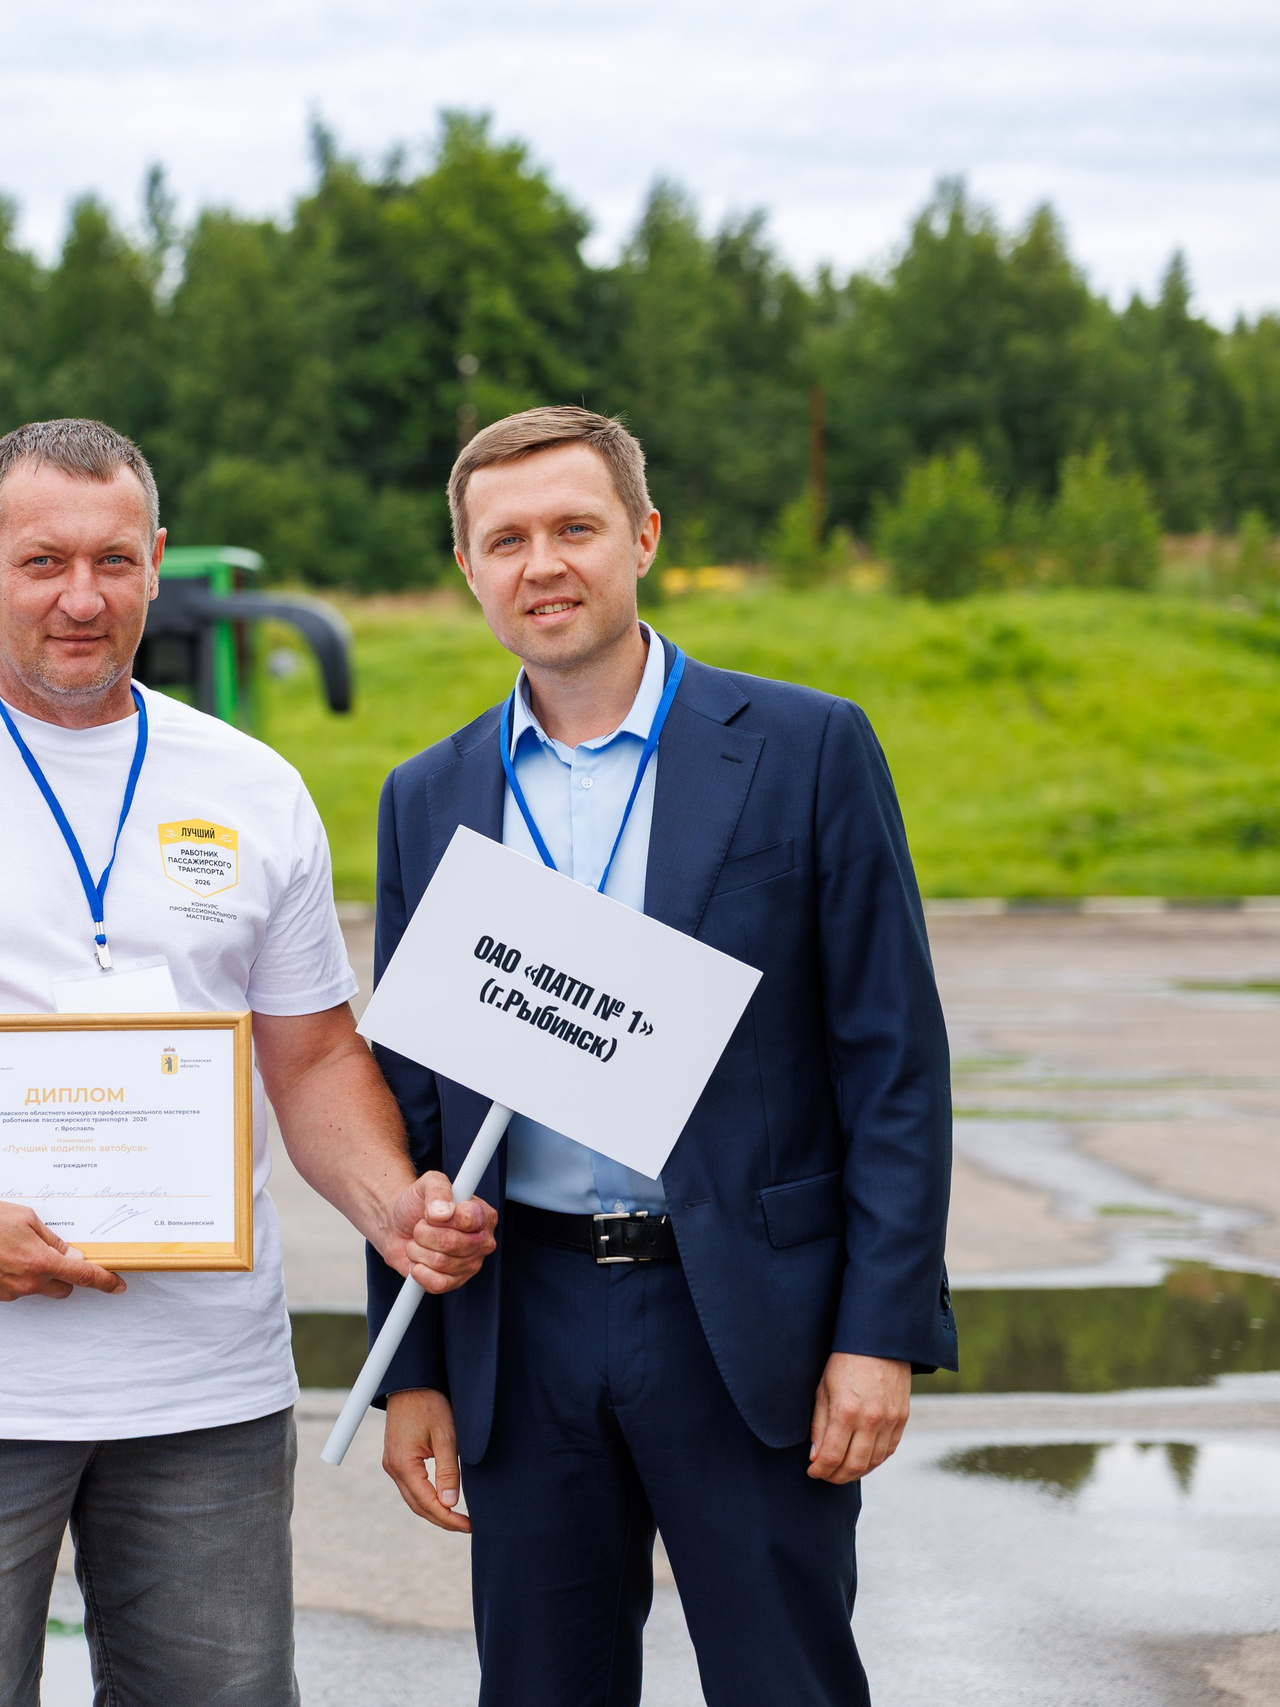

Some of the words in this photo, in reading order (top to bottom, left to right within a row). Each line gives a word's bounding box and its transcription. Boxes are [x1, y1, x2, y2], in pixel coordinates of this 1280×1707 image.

[181, 827, 215, 839] ЛУЧШИЙ
[180, 849, 219, 858] РАБОТНИК
[168, 857, 232, 869] ПАССАЖИРСКОГО
[178, 866, 225, 876] ТРАНСПОРТА
[191, 901, 219, 910] КОНКУРС
[169, 906, 237, 920] ПРОФЕССИОНАЛЬНОГО
[186, 914, 225, 924] МАСТЕРСТВА
[473, 935, 522, 974] ОАО
[524, 963, 595, 1011] «ПАТП
[592, 993, 626, 1021] №
[627, 1010, 654, 1037] 1»
[479, 977, 618, 1063] (г.Рыбинск)
[24, 1087, 125, 1106] ДИПЛОМ
[3, 1144, 48, 1154] «Лучший
[51, 1145, 96, 1153] водитель
[99, 1144, 148, 1153] автобуса»
